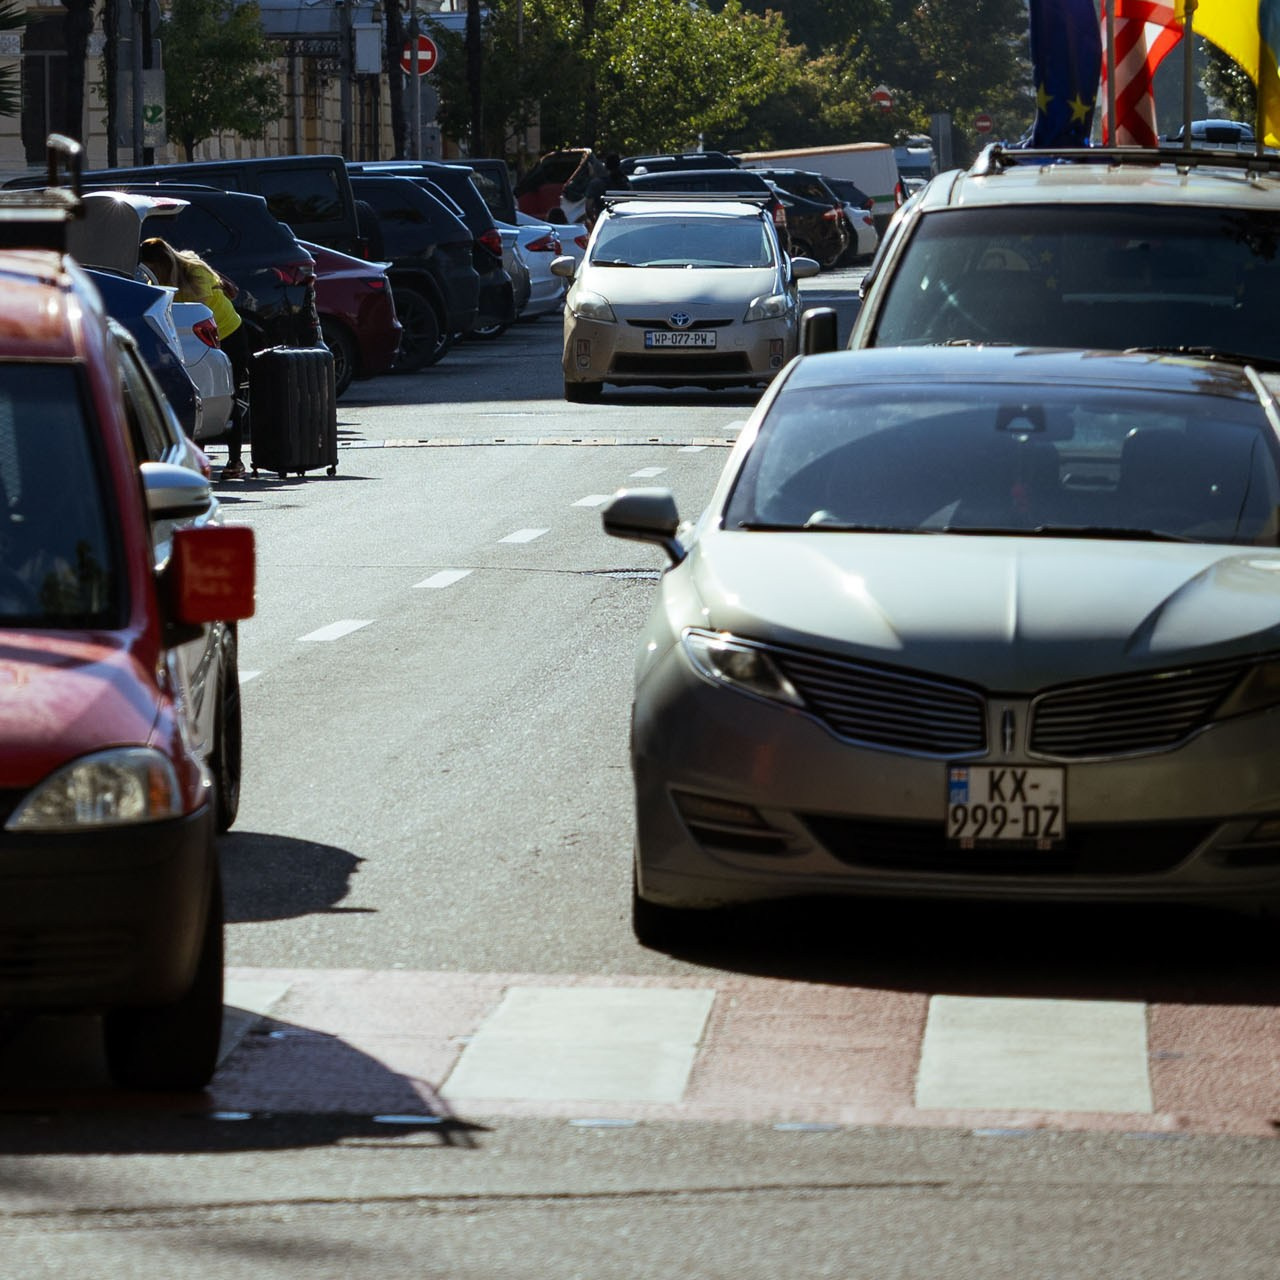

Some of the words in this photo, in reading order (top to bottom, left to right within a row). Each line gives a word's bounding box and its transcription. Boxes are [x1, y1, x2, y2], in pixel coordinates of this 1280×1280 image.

[654, 333, 707, 345] WP-077-PW
[988, 769, 1040, 803] KX-
[951, 804, 1060, 839] 999-DZ
